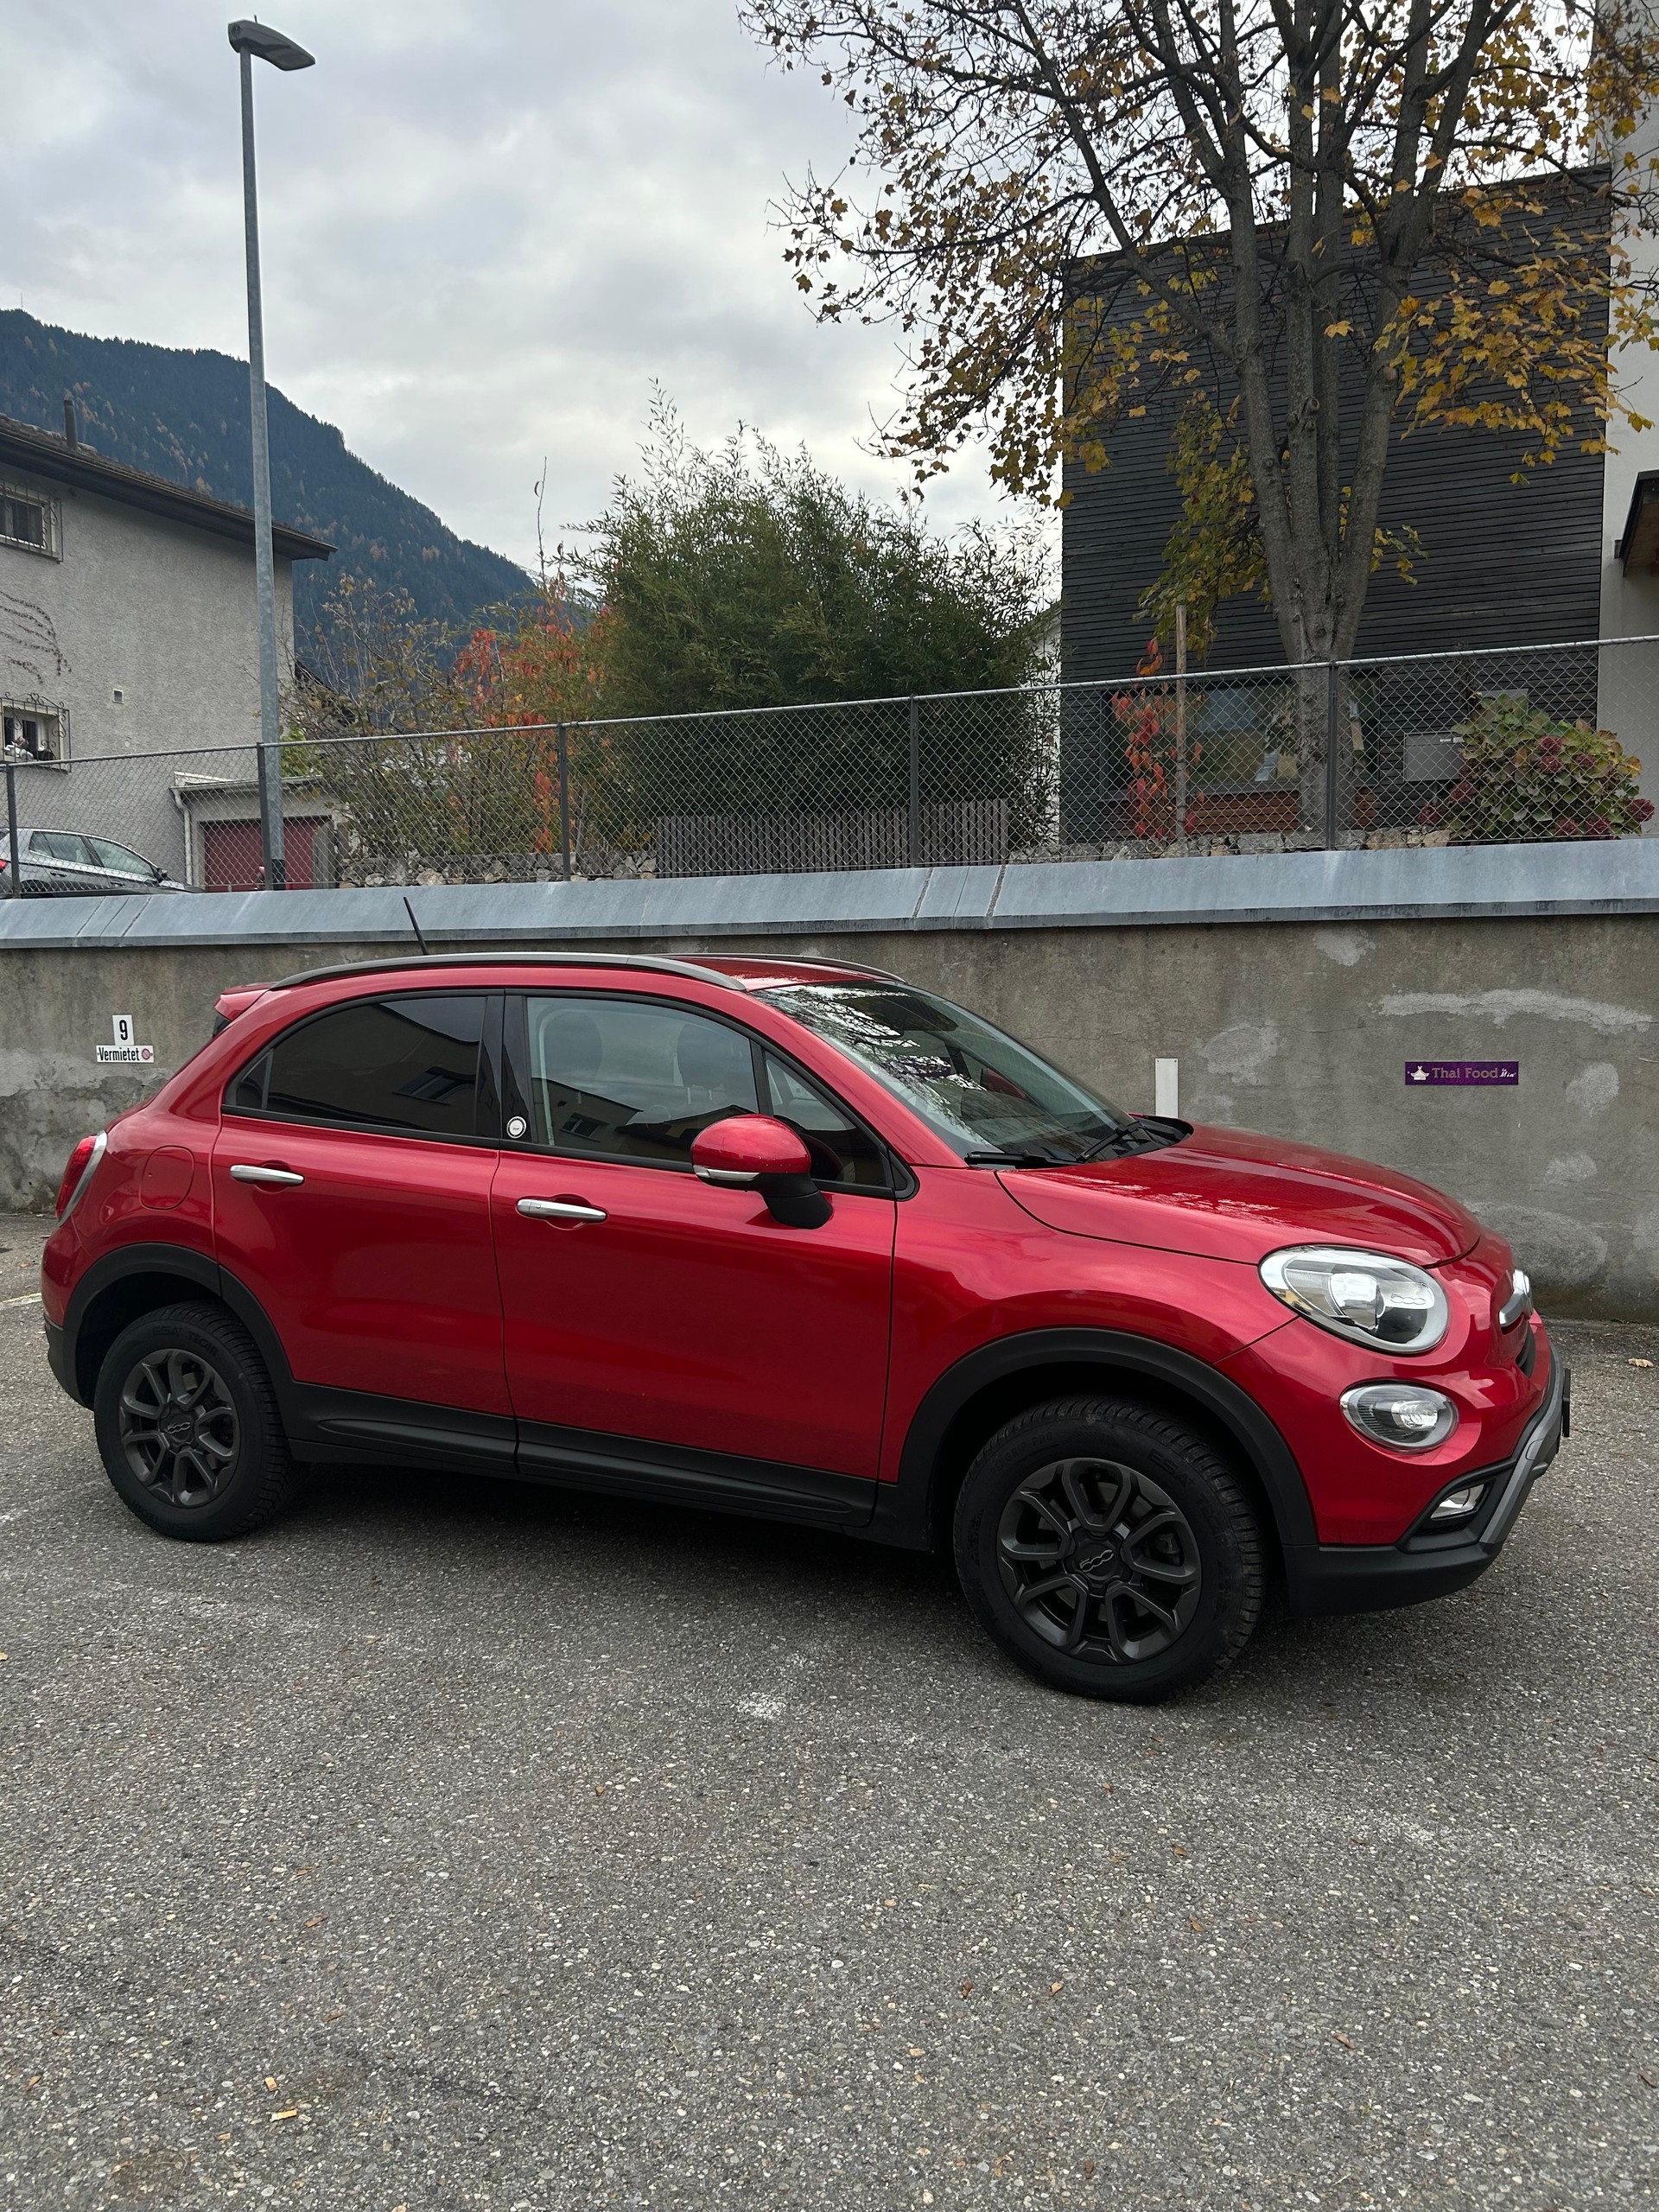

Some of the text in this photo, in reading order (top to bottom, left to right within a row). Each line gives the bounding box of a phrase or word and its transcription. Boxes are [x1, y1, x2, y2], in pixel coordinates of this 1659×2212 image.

[119, 1020, 128, 1040] 9
[99, 1046, 140, 1061] Vermietet
[1432, 1067, 1499, 1078] Thai Food
